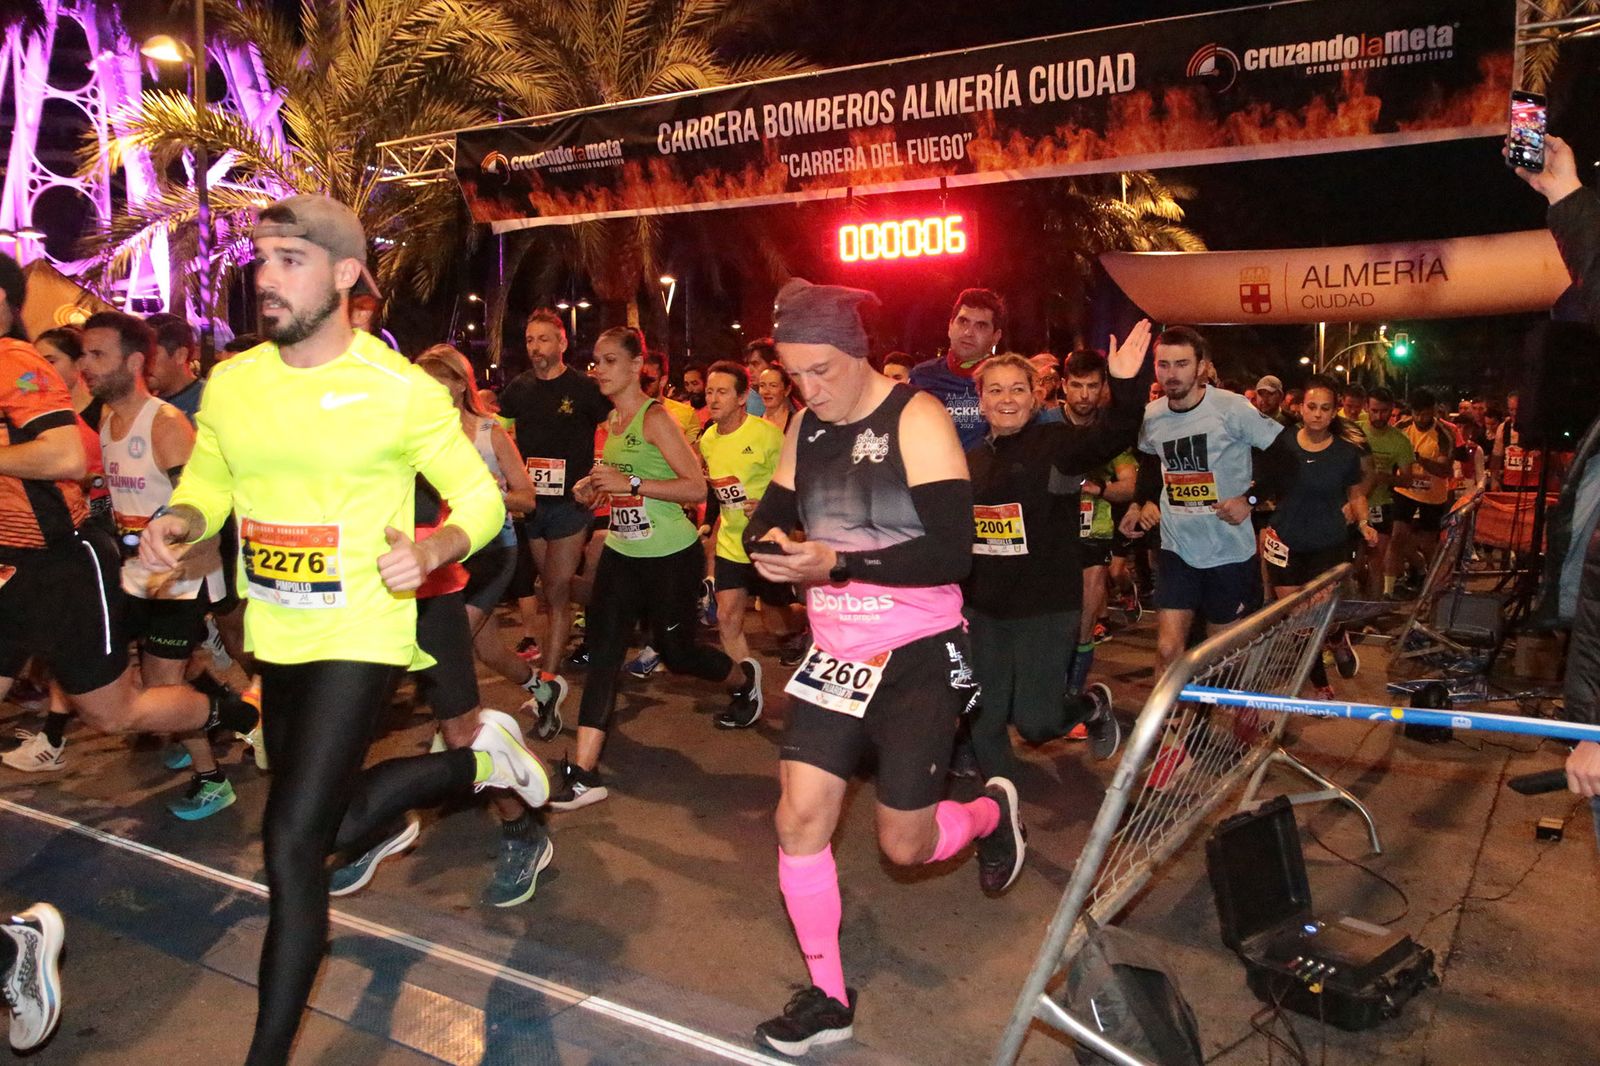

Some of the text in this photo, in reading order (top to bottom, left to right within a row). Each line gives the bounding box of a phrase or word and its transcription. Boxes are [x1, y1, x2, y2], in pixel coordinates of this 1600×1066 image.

[657, 51, 1136, 156] CARRERA BOMBEROS ALMERÍA CIUDAD
[870, 143, 905, 170] DEL
[1301, 254, 1449, 289] ALMERÍA
[1301, 292, 1375, 310] CIUDAD
[109, 461, 120, 475] GO
[534, 469, 552, 483] 51
[1175, 484, 1210, 499] 2469
[615, 508, 641, 525] 103
[980, 520, 1014, 535] 2001
[257, 548, 325, 574] 2276
[811, 587, 895, 612] Sorbas
[819, 657, 872, 690] 260
